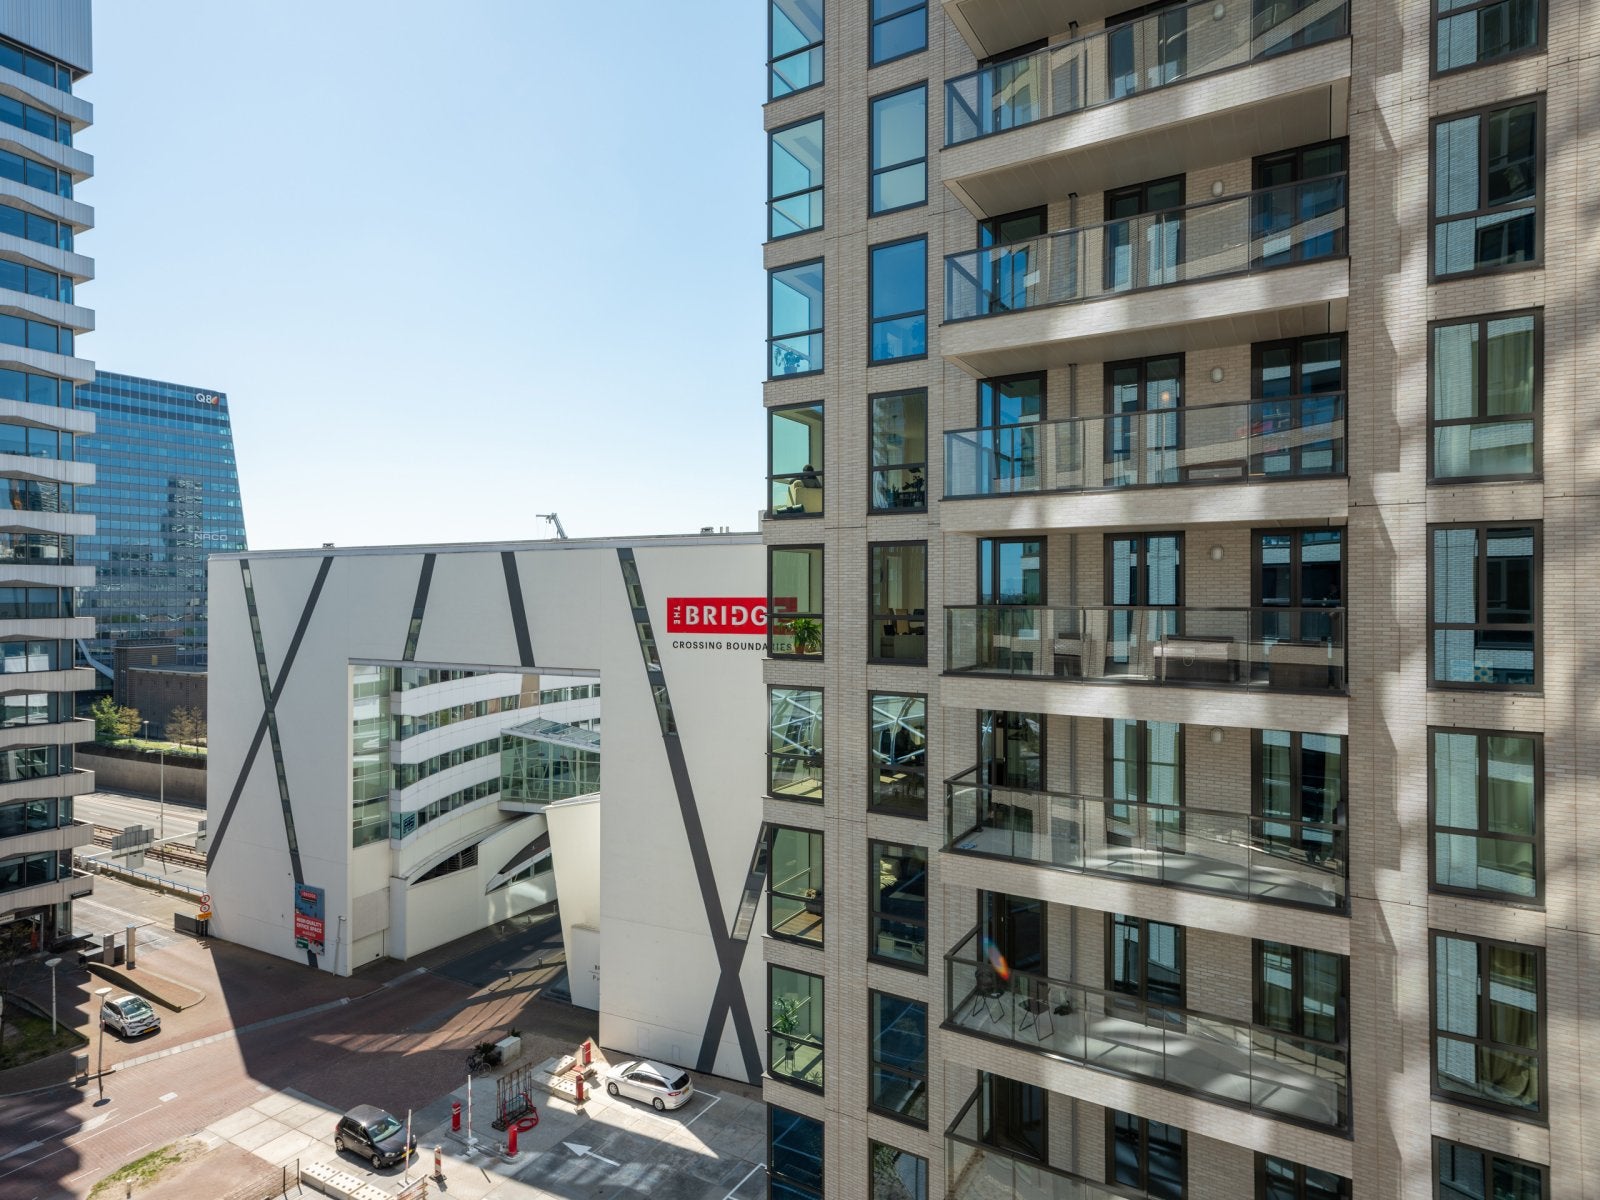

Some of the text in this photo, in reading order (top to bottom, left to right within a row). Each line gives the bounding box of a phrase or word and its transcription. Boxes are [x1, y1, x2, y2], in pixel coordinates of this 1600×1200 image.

[196, 393, 212, 404] Q8
[194, 533, 228, 541] NACO
[673, 606, 681, 625] THE
[672, 641, 792, 651] CROSSING BOUNDAIES
